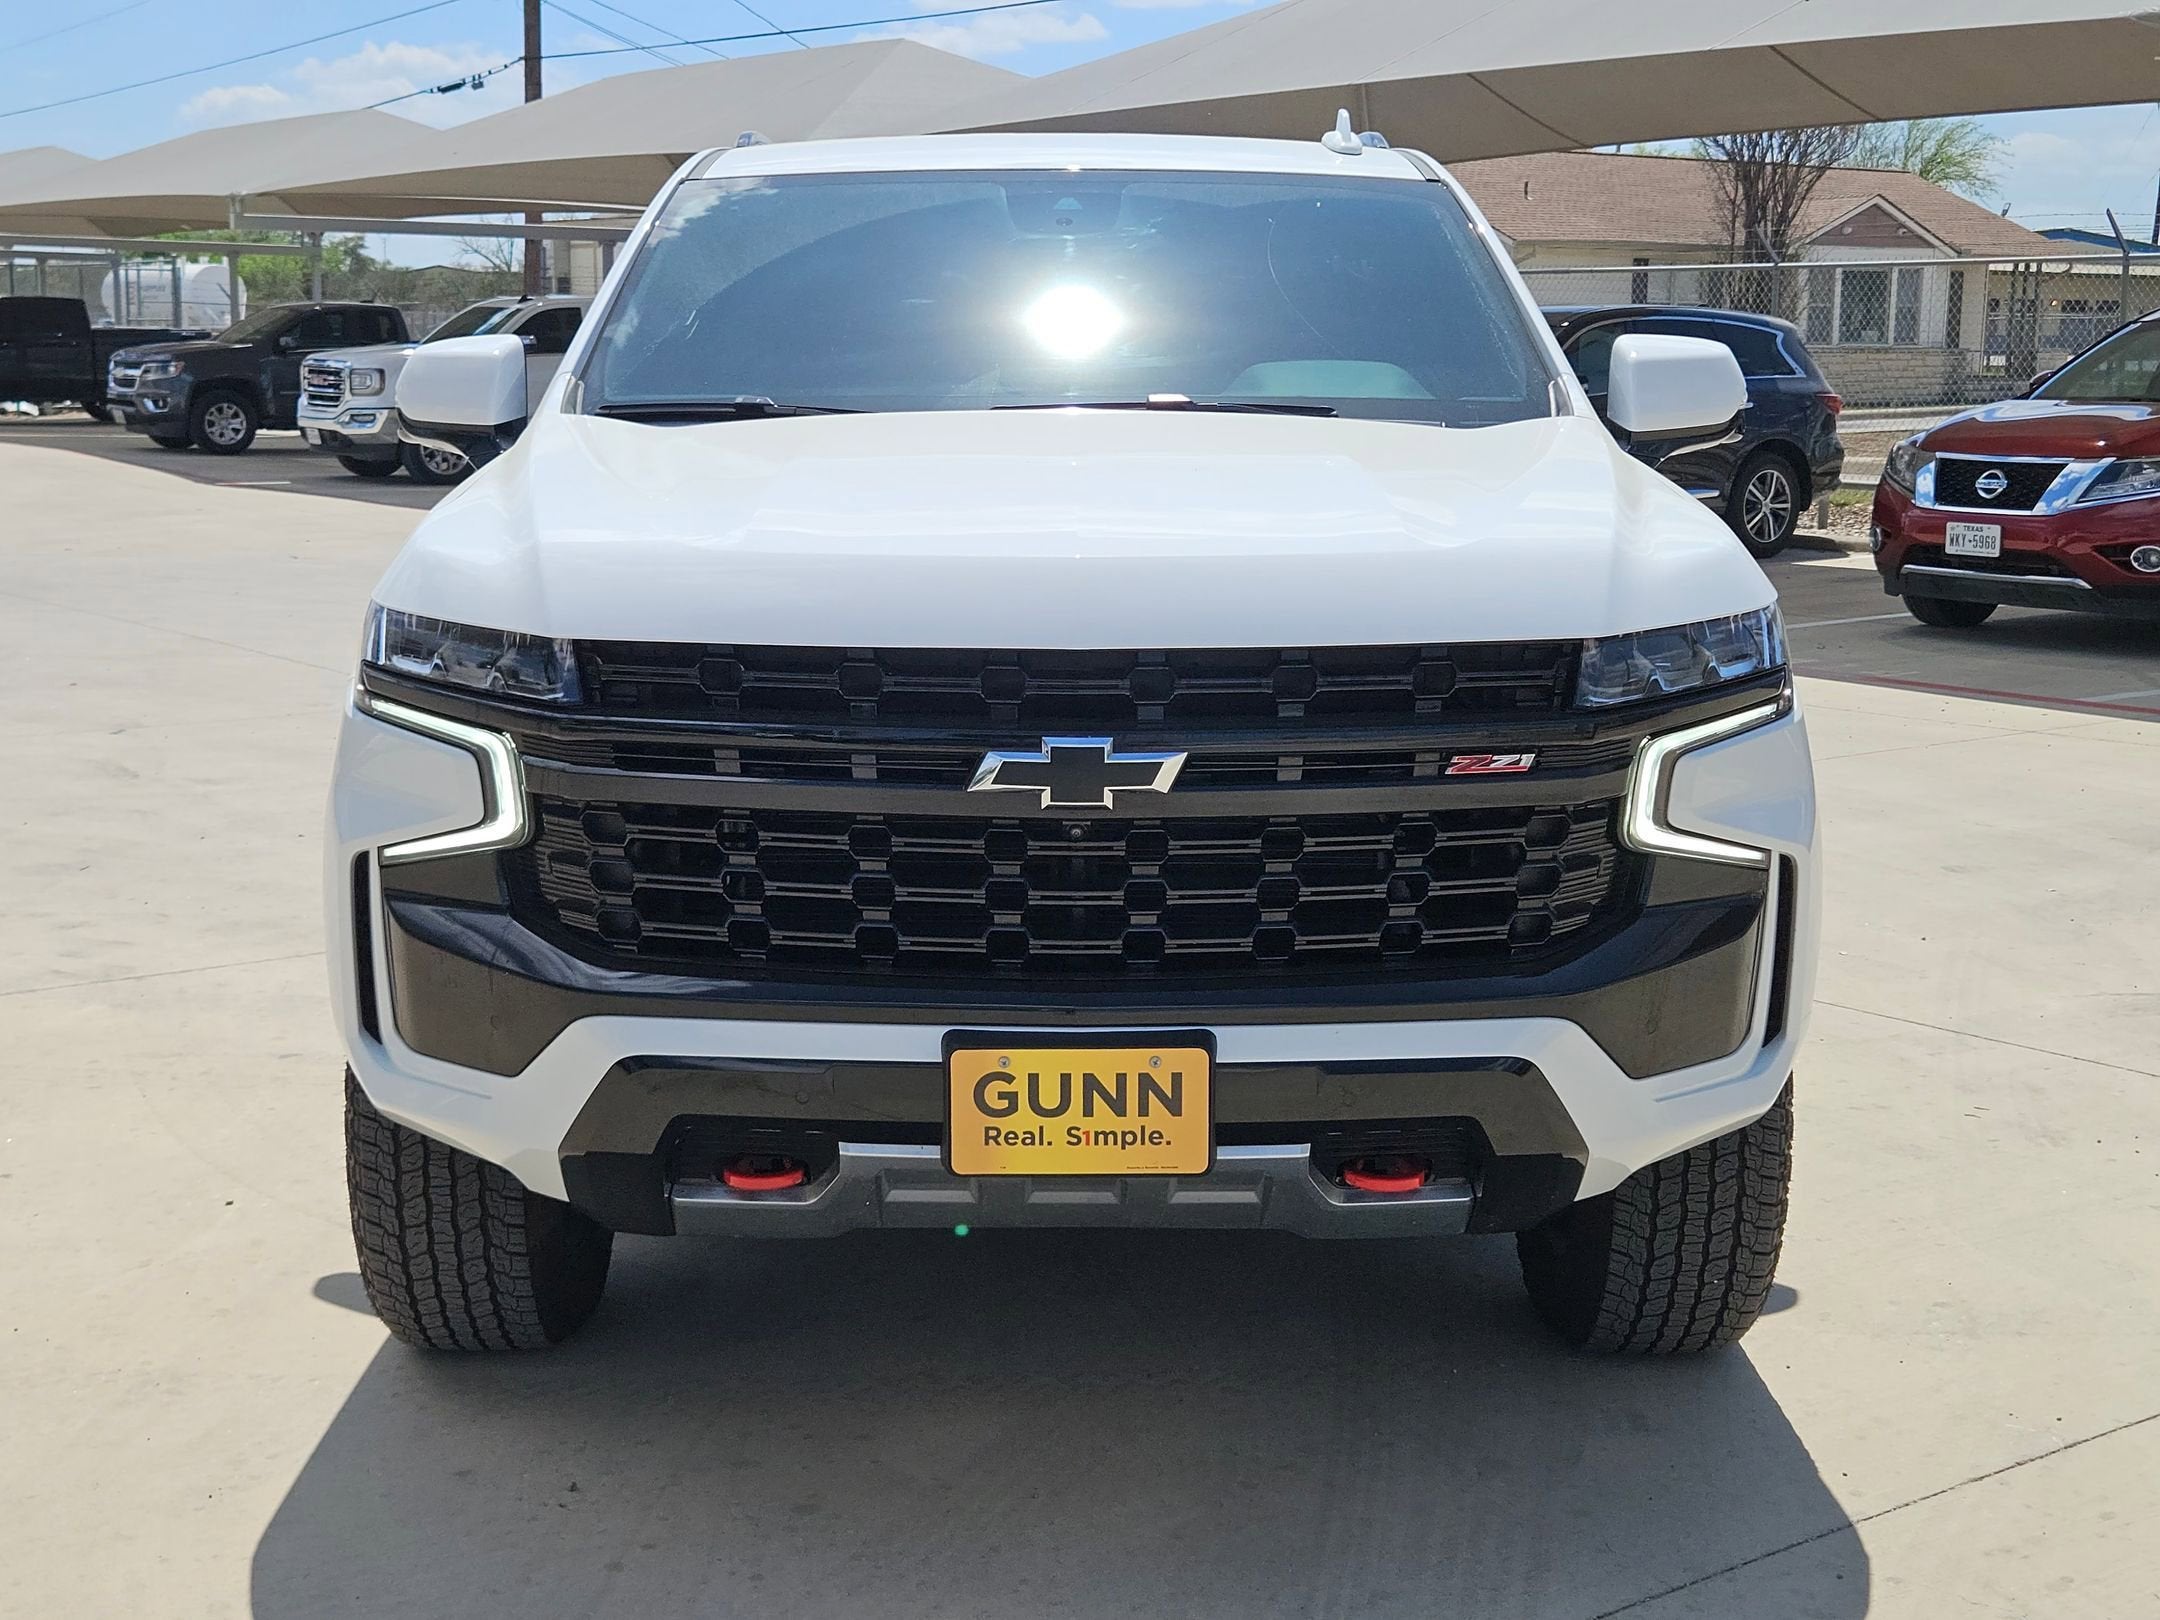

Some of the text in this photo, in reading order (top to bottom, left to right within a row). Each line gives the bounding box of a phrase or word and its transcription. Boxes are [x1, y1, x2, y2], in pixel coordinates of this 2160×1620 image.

[1445, 754, 1535, 774] Z71
[973, 1071, 1183, 1118] GUNN
[984, 1125, 1172, 1150] Real. S1mple.
